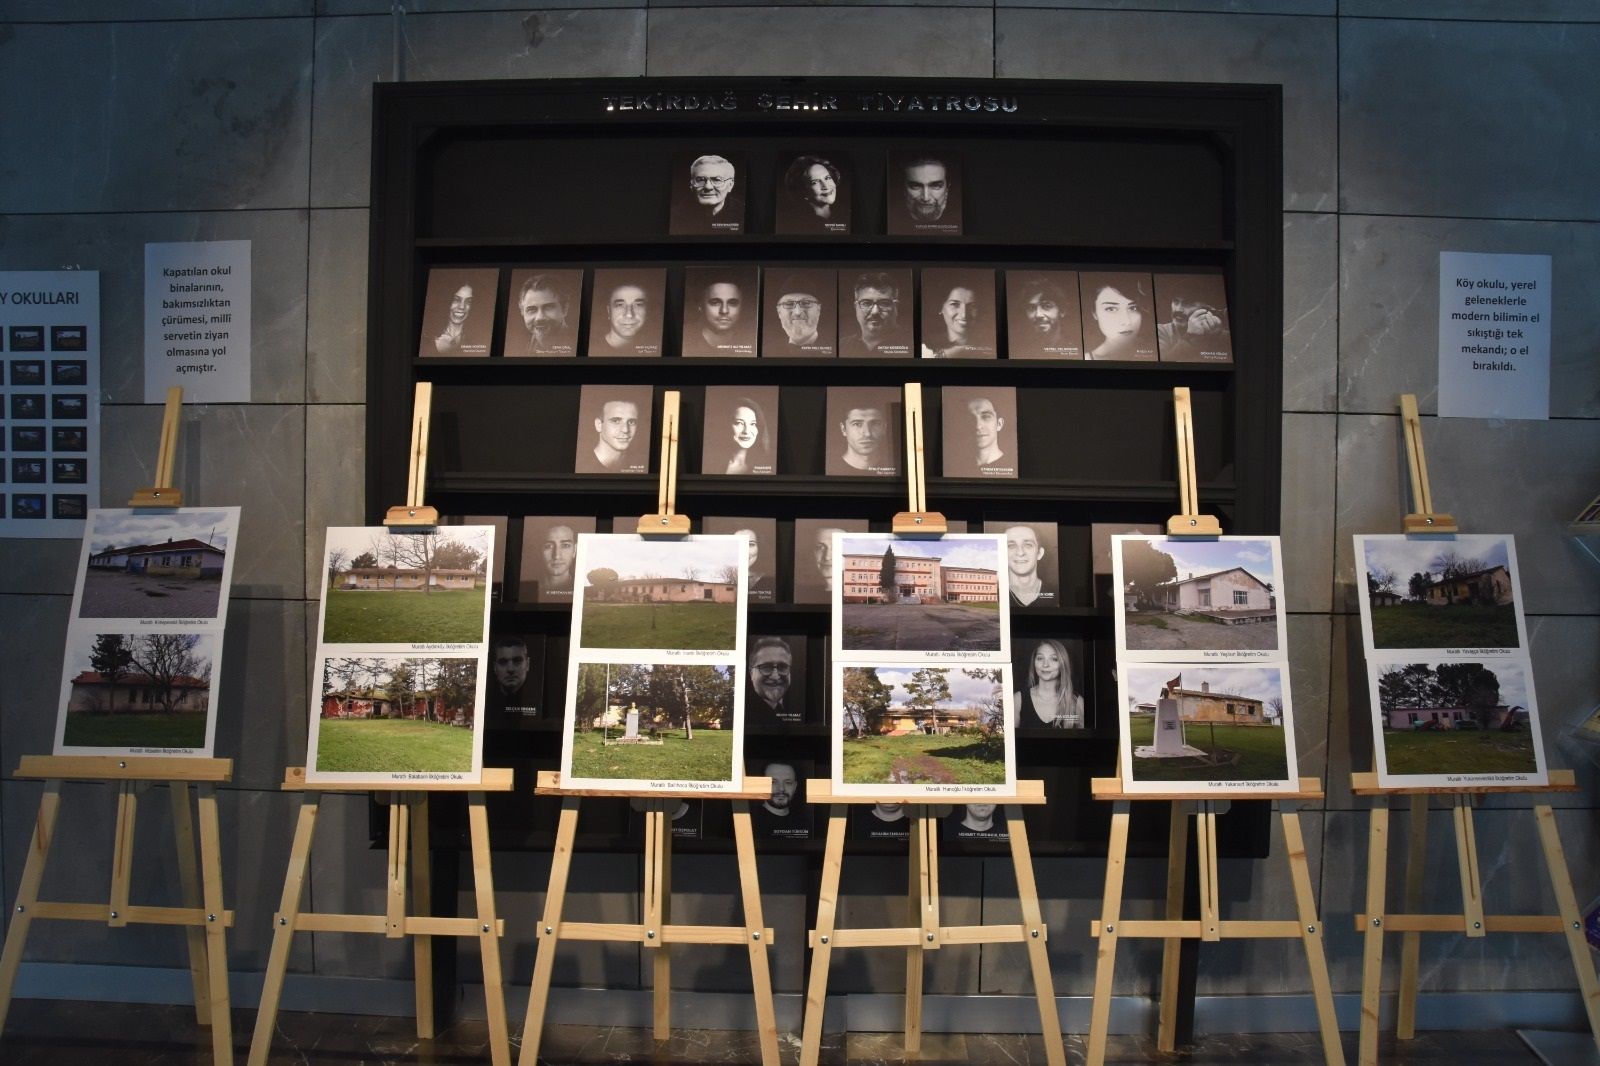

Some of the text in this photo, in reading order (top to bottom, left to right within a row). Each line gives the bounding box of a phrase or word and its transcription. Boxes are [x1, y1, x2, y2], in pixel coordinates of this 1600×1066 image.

[602, 91, 1018, 113] TEKİRDAĞ ŞEHİR TİYATROSU
[163, 266, 231, 279] Kapatılan okul
[169, 282, 224, 293] binalarının,
[1456, 278, 1537, 291] Köy okulu, yerel
[11, 292, 79, 306] OKULLARI
[162, 298, 231, 309] bakımsızlıktan
[1464, 295, 1527, 307] geleneklerle
[162, 315, 208, 327] çürümesi,
[1451, 311, 1540, 323] modern bilimin el
[163, 330, 229, 342] servetin ziyan
[1467, 327, 1524, 340] sıkıştığı tek
[166, 346, 226, 358] olmasına yol
[1461, 344, 1508, 356] mekandı;
[1519, 345, 1529, 356] el
[175, 363, 217, 375] açmıştır.
[1472, 360, 1517, 371] bırakıldı.
